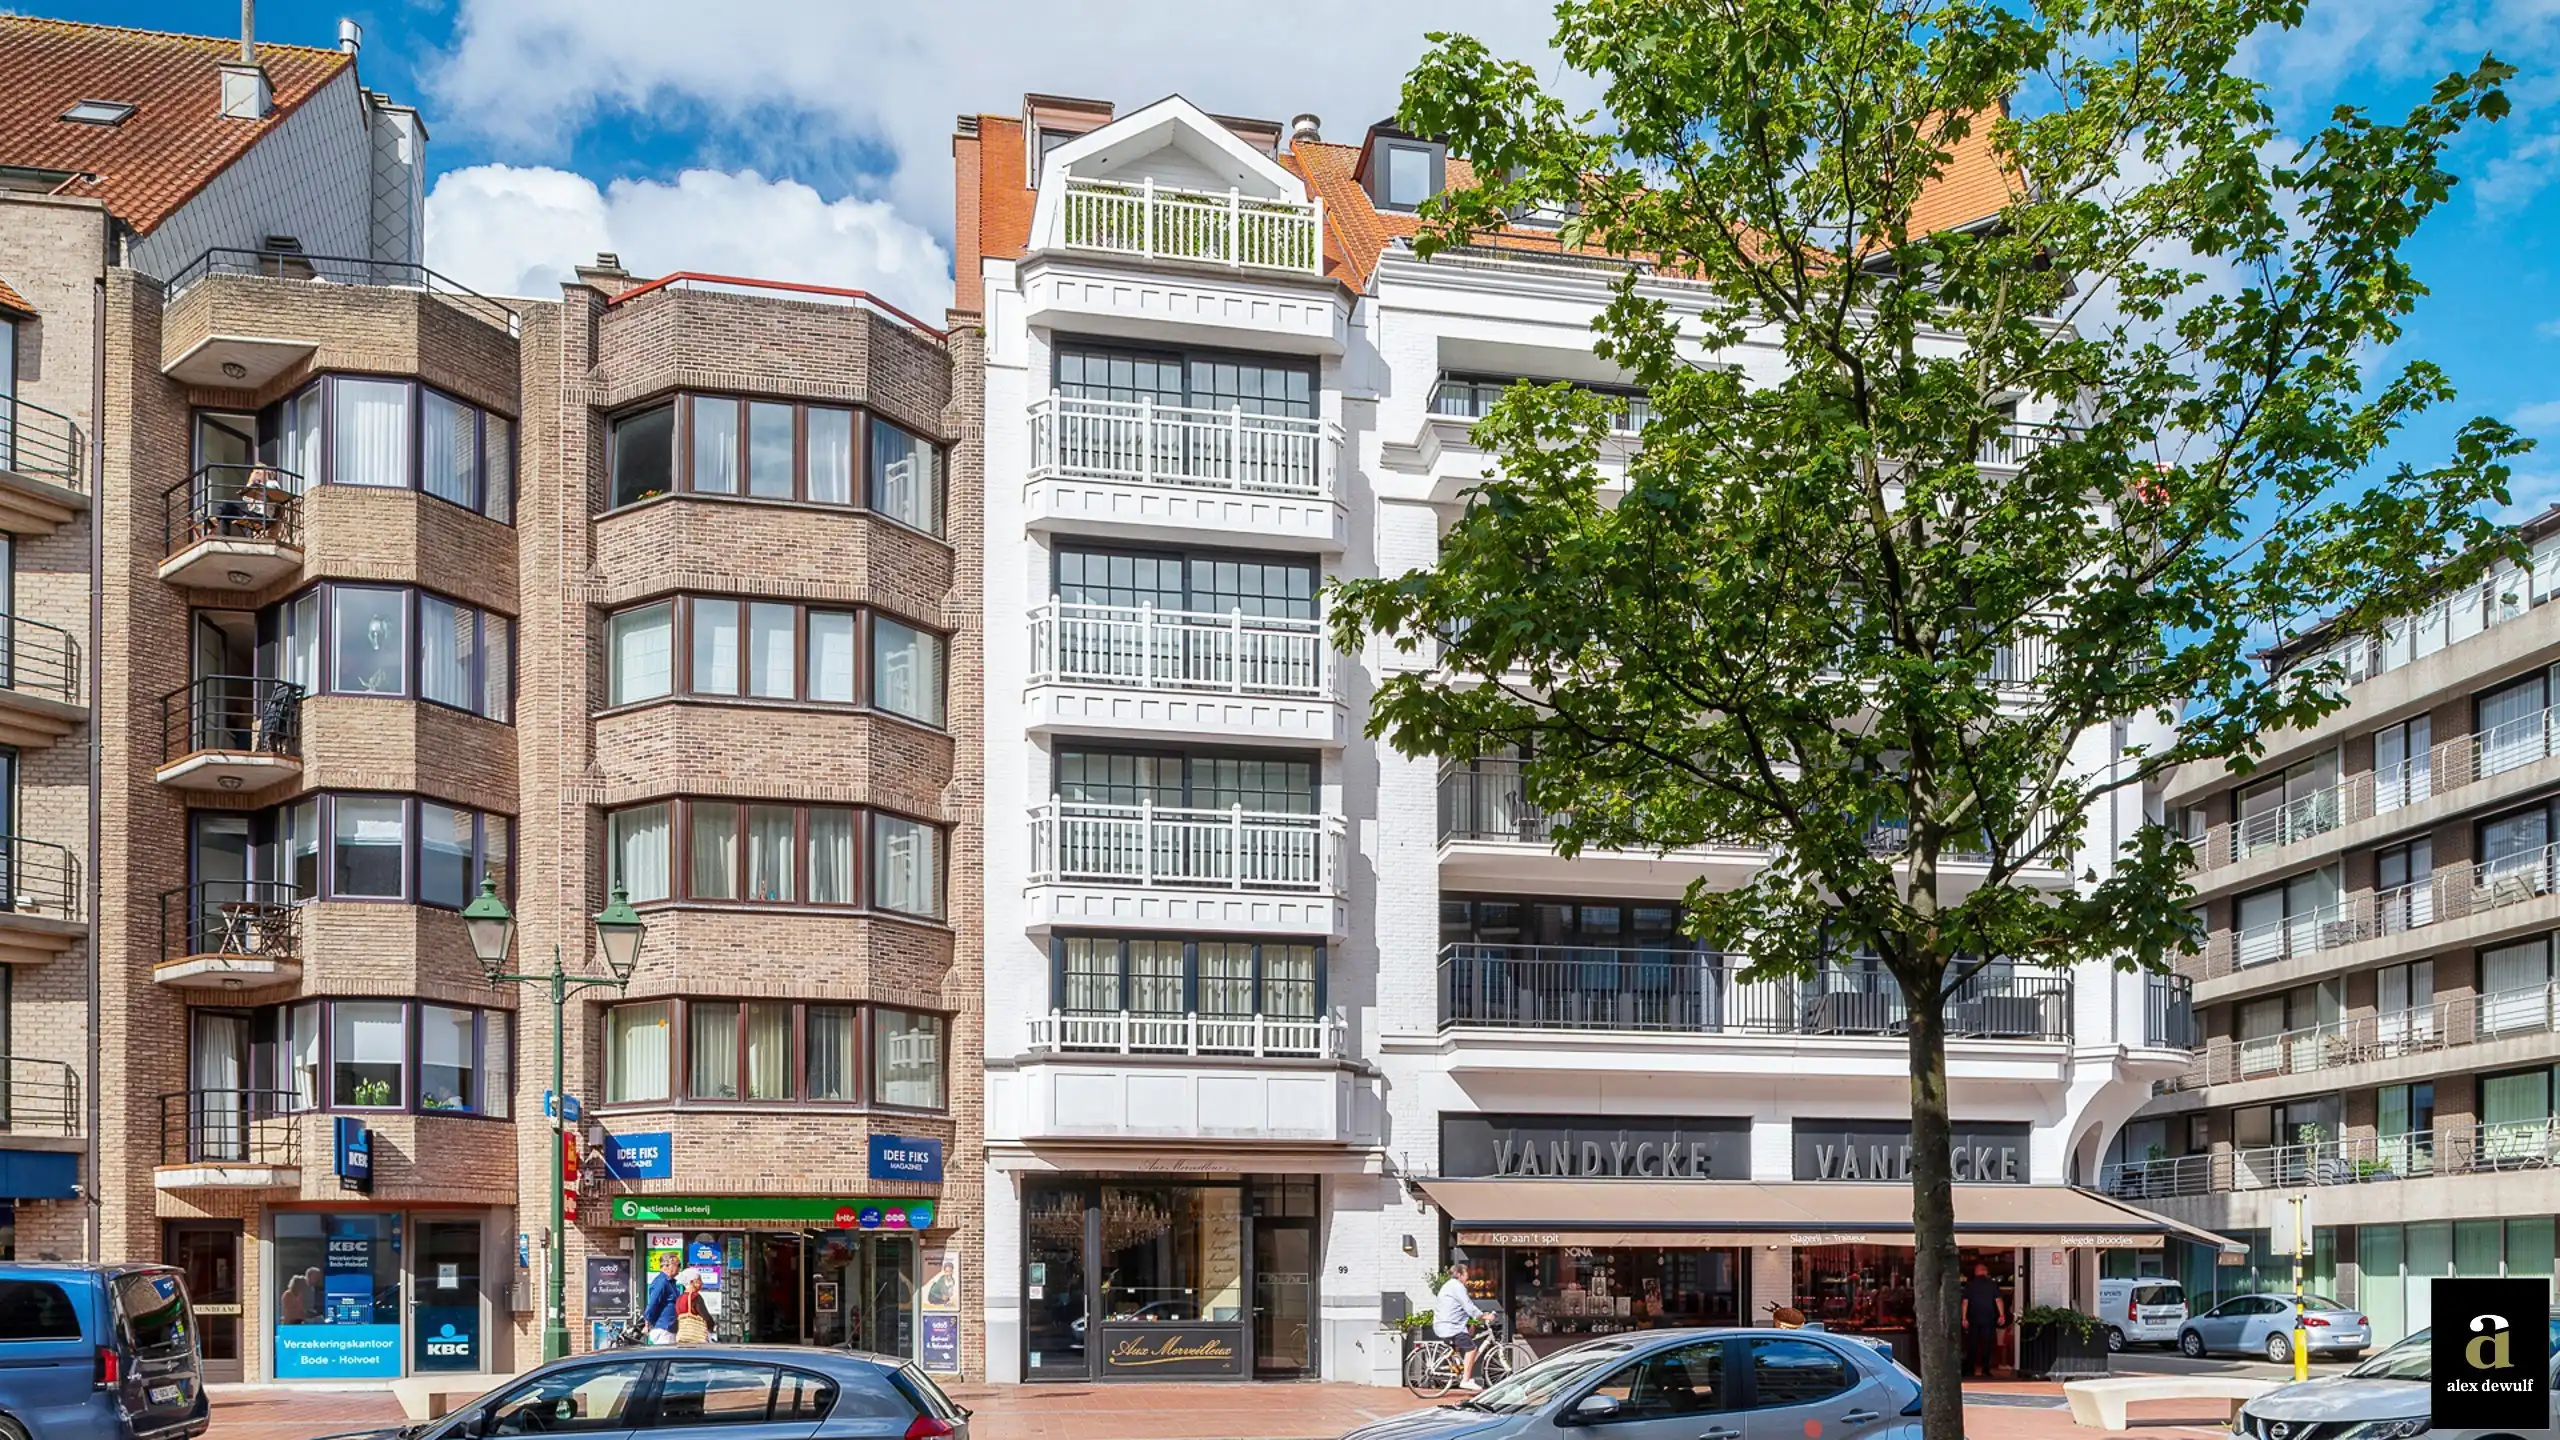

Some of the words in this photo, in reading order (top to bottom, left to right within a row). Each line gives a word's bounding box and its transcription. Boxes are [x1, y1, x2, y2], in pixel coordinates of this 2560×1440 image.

[616, 1147, 637, 1160] IDEE
[639, 1146, 659, 1159] FIKS
[883, 1149, 906, 1162] IDEE
[908, 1151, 929, 1163] FIKS
[1492, 1139, 1707, 1177] VANDYCKE
[889, 1162, 923, 1171] MAGAZINES
[1815, 1144, 2016, 1181] VANDCKE
[640, 1204, 682, 1213] nationale
[684, 1204, 710, 1216] loterij
[1492, 1232, 1509, 1245] Kip
[1542, 1232, 1560, 1246] spit
[1790, 1233, 1822, 1245] Slagerij
[2060, 1235, 2095, 1246] Belegde
[2096, 1235, 2133, 1246] Broodjes
[328, 1241, 368, 1252] KBC
[1338, 1266, 1348, 1274] 99
[283, 1339, 394, 1350] Verzekeringskantoor
[427, 1344, 469, 1356] KBC
[1112, 1335, 1149, 1356] Aux
[1151, 1335, 1232, 1356] Merveilleux
[300, 1355, 328, 1365] Bode
[339, 1355, 380, 1365] Holvoet
